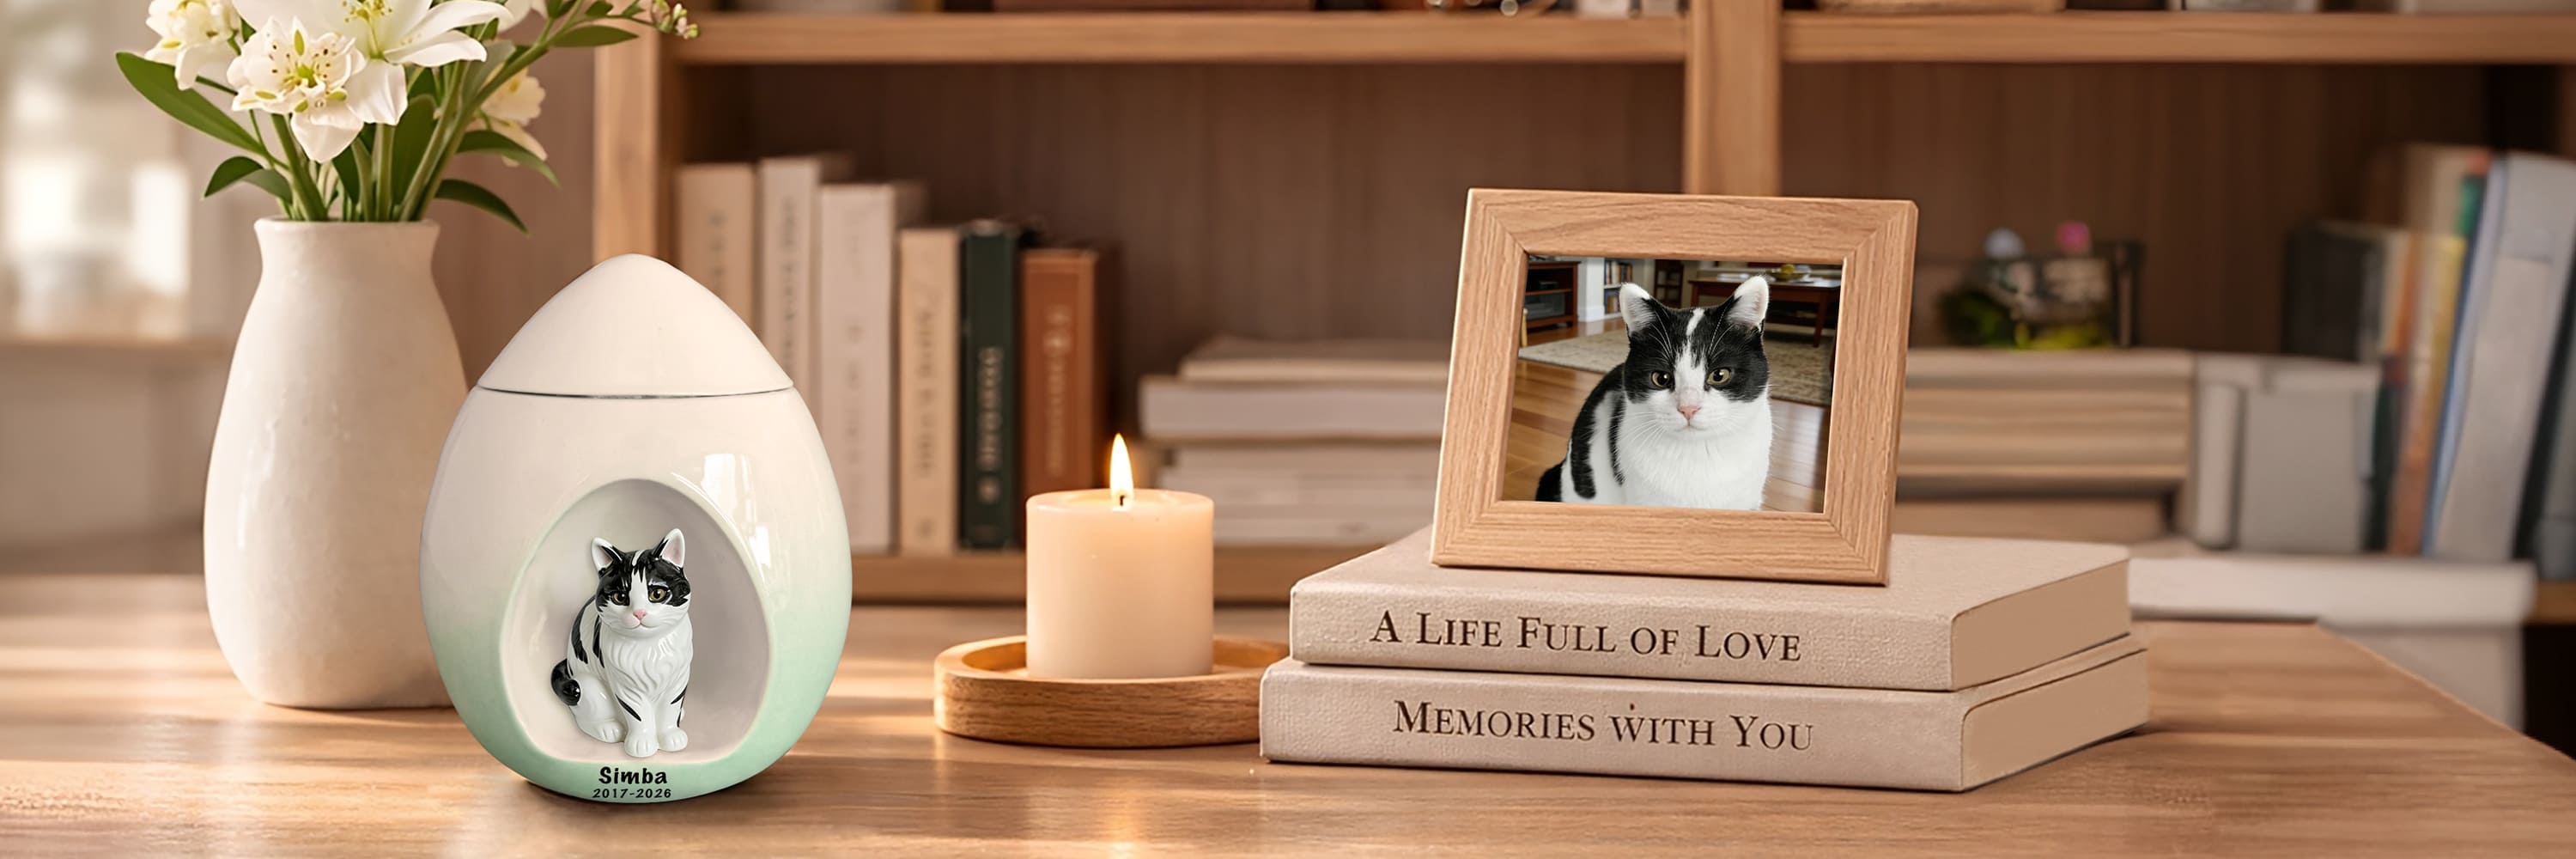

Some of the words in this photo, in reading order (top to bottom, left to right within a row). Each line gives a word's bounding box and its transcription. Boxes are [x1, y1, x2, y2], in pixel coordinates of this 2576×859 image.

[1369, 609, 1402, 643] A
[1416, 612, 1503, 648] LIFE
[1516, 616, 1617, 653] FULL
[1630, 627, 1680, 655] OF
[1694, 624, 1801, 661] LOVE
[1393, 699, 1595, 741] MEMORIES
[1608, 716, 1716, 746] WITH
[1729, 714, 1814, 751] YOU
[598, 765, 668, 785] Simba
[592, 788, 672, 799] 2017-2026
